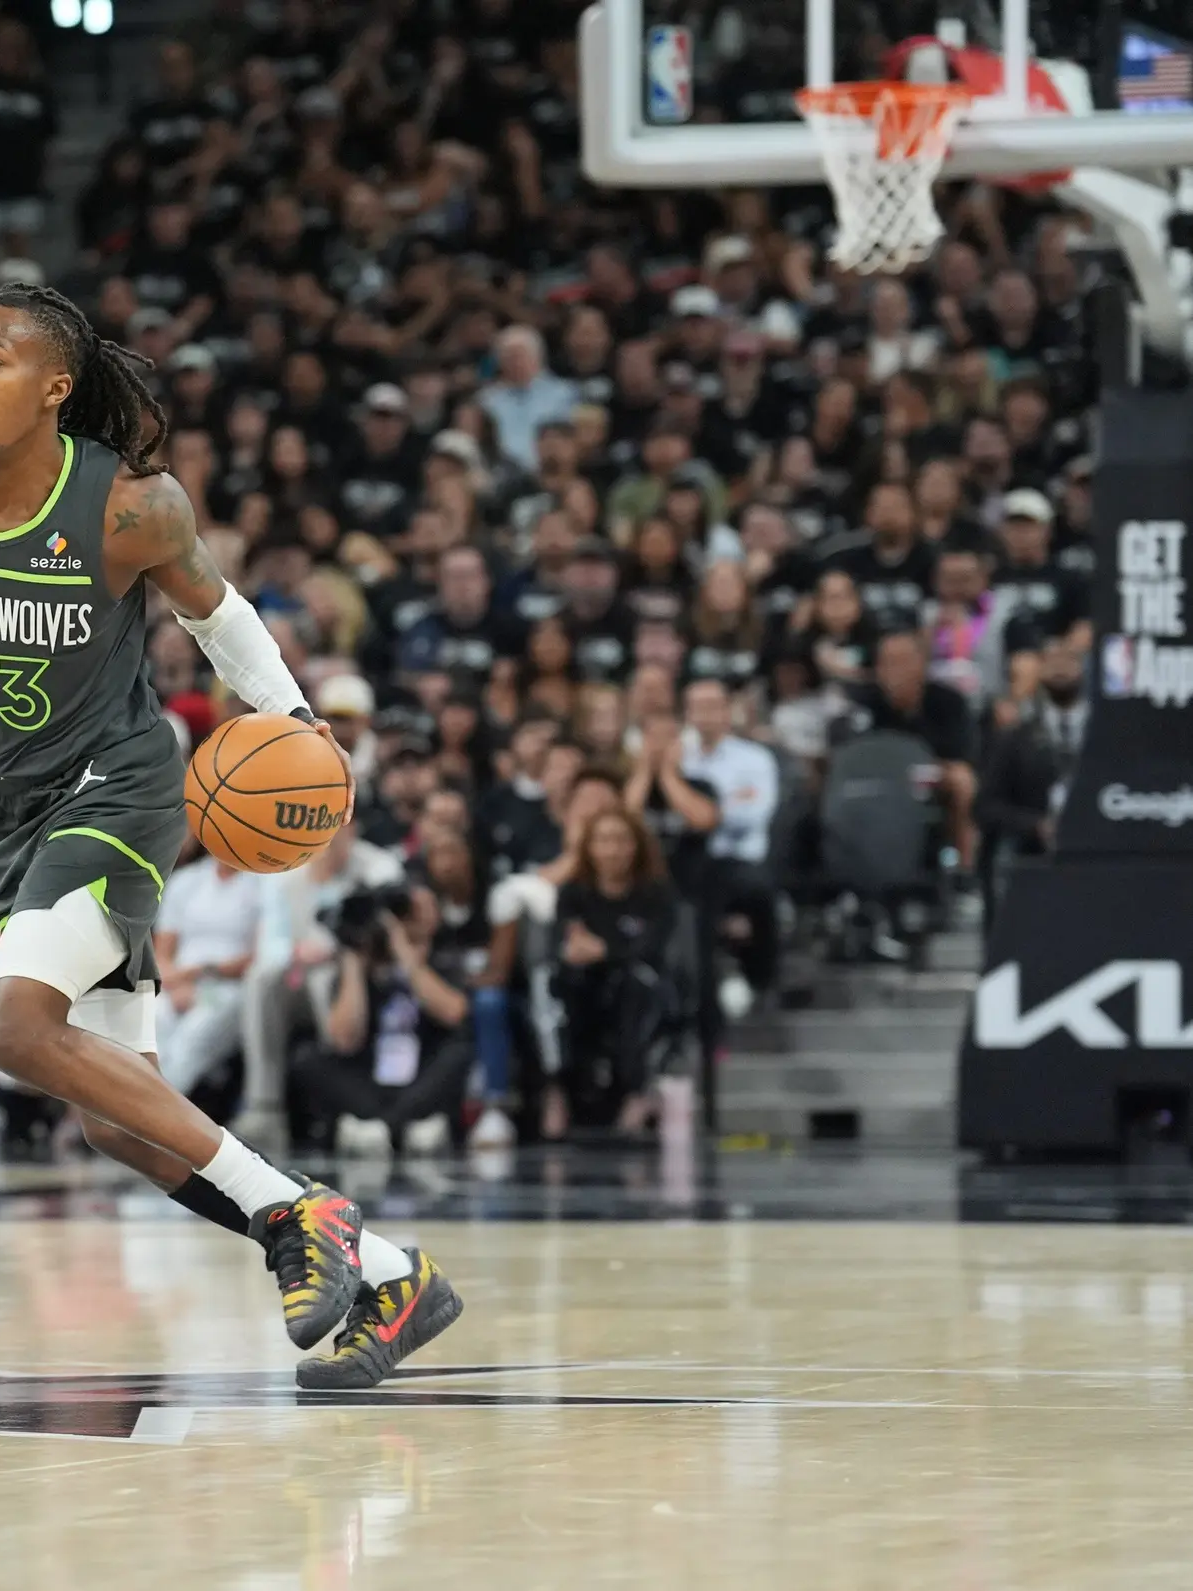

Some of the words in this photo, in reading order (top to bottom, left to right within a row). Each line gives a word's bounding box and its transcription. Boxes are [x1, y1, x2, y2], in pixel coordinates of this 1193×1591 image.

[30, 555, 83, 570] sezzle
[1119, 577, 1186, 637] THE
[274, 800, 344, 832] Wilso
[1098, 783, 1193, 828] Googl
